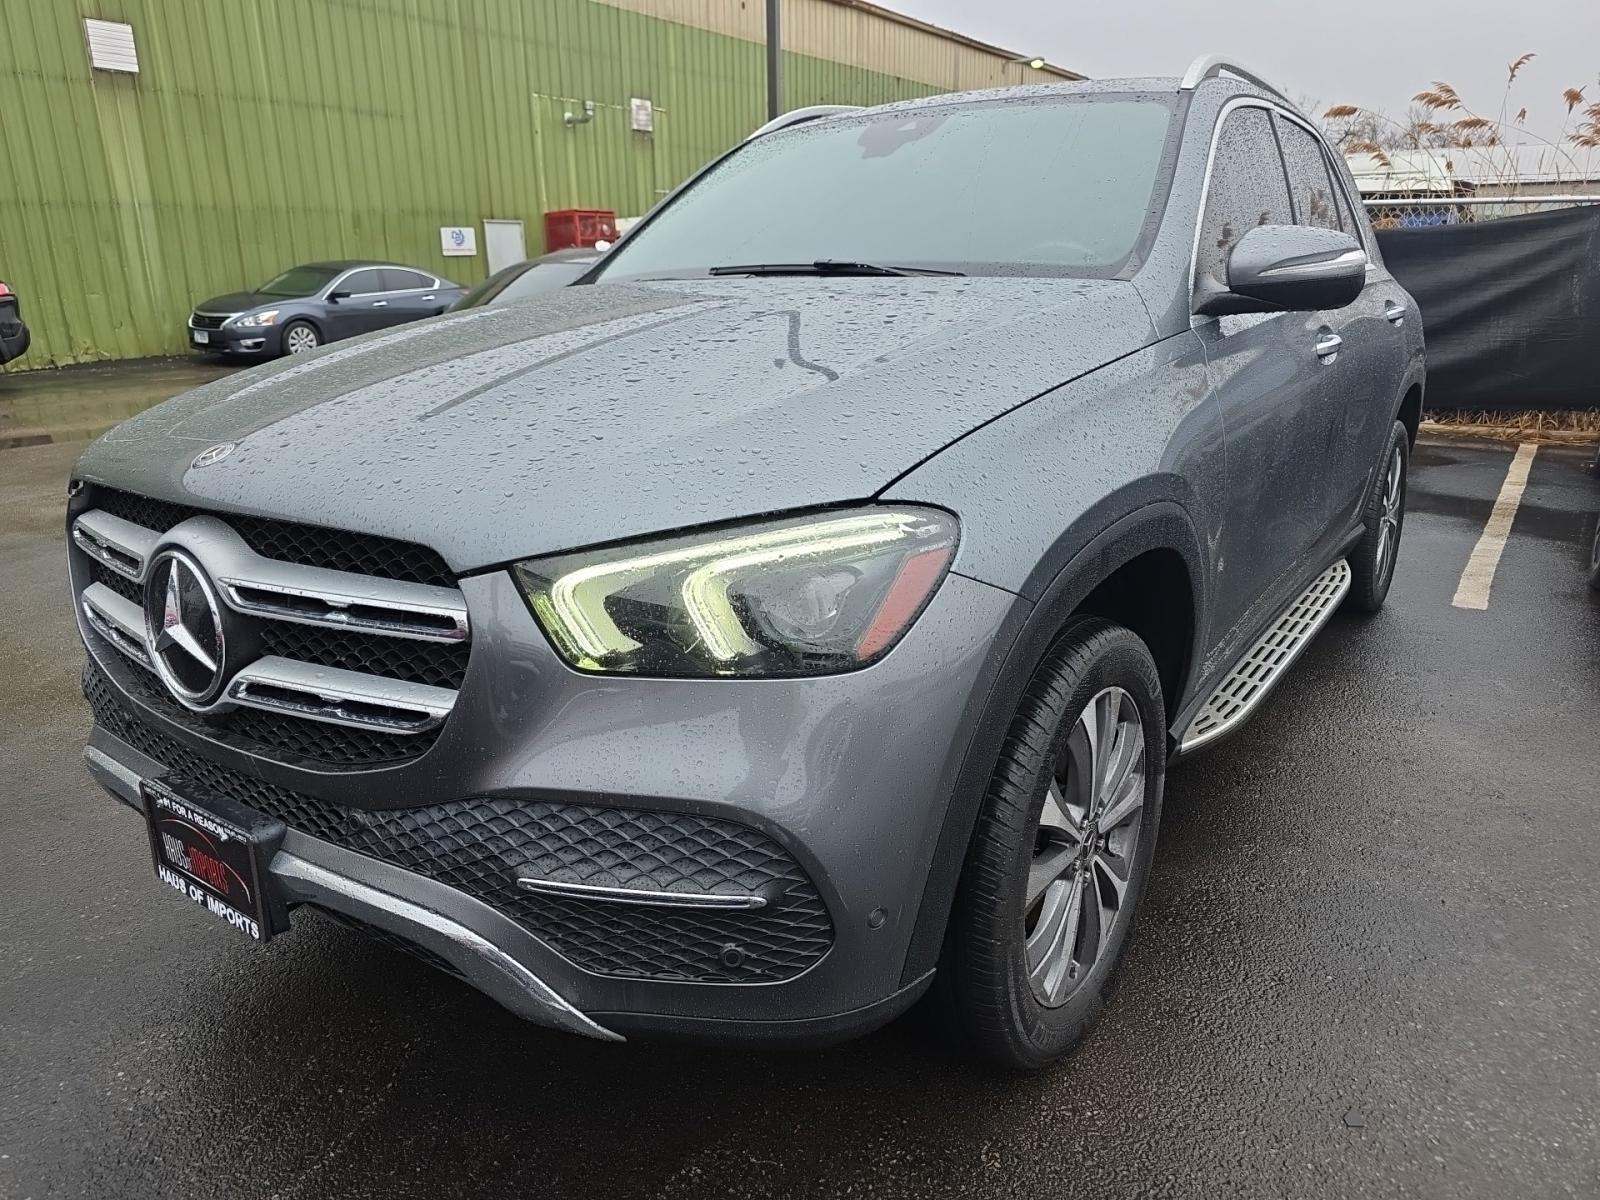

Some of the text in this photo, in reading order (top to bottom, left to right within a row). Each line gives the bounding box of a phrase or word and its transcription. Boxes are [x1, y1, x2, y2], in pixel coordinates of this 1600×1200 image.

[172, 802, 187, 818] FOR
[188, 810, 194, 821] A
[194, 813, 225, 836] REASON
[158, 865, 259, 939] HAUS OF IMPORTS
